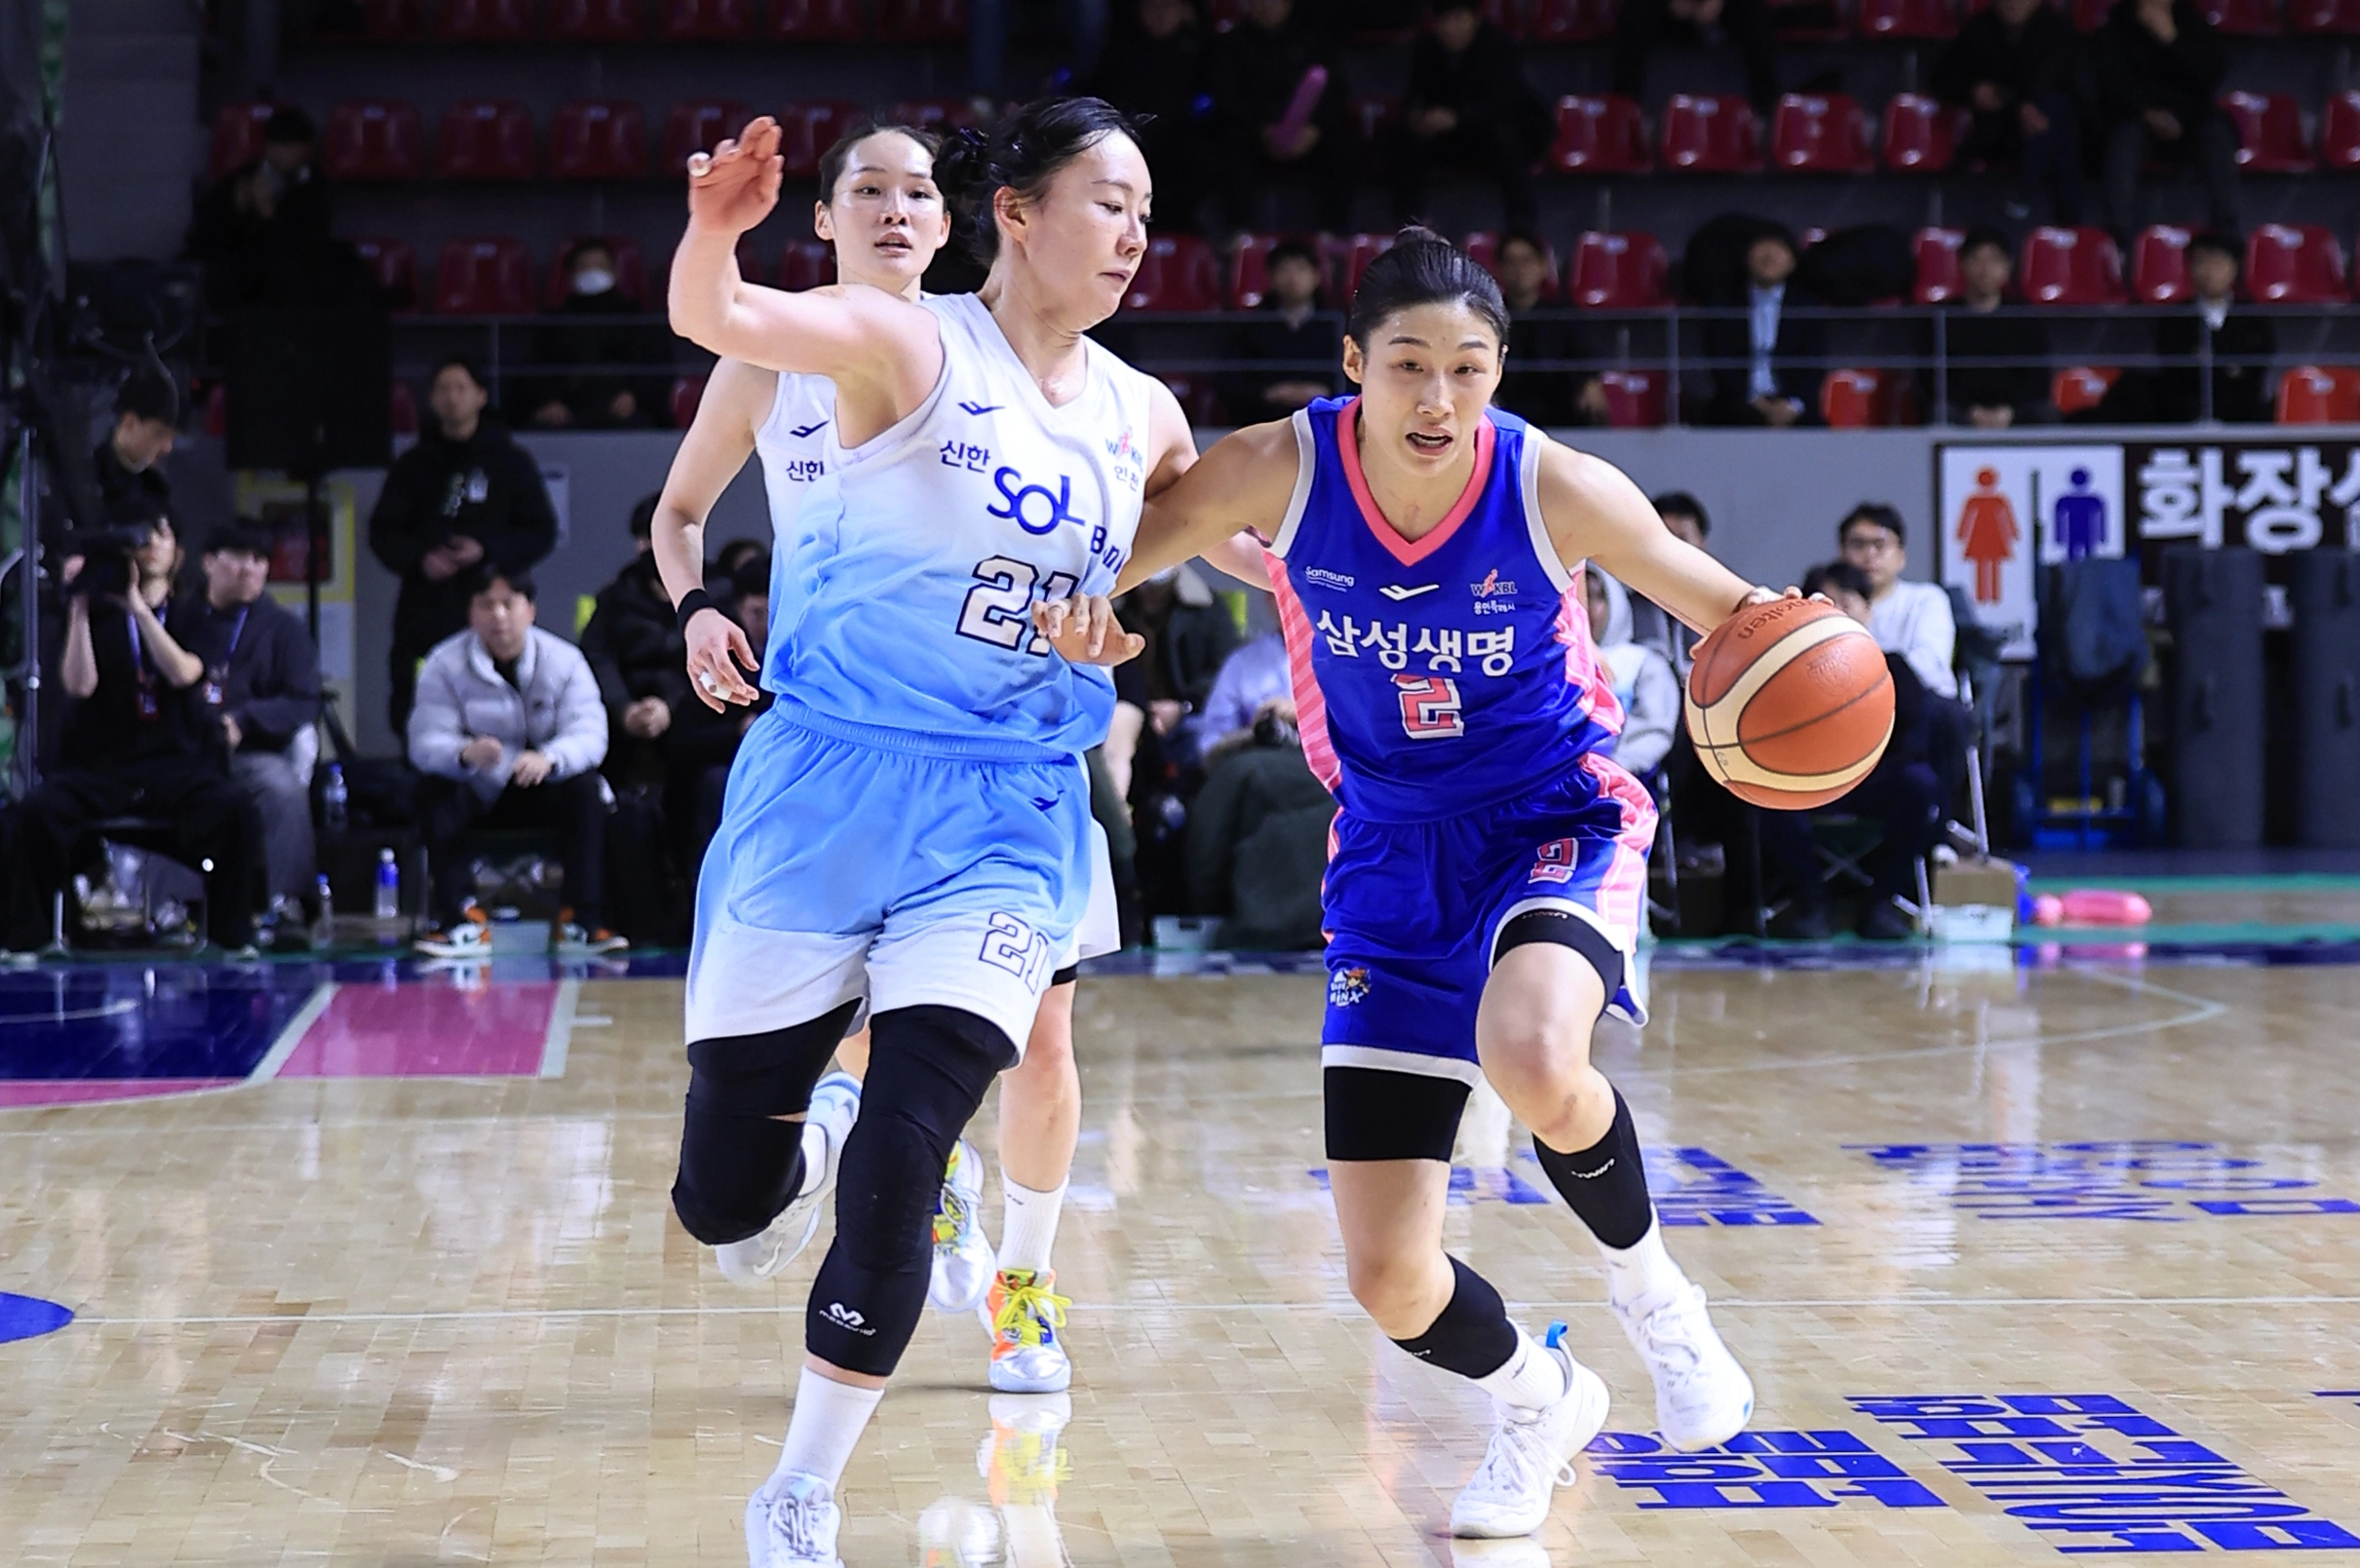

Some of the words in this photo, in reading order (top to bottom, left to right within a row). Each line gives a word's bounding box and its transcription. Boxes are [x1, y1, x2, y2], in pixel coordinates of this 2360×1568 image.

[786, 460, 825, 482] 신한
[940, 440, 991, 474] 신한
[2137, 446, 2360, 555] 화장
[1305, 565, 1355, 588] Samsung
[1316, 609, 1515, 677] 삼성생명
[1391, 672, 1464, 740] 2
[1528, 836, 1579, 884] 2
[978, 910, 1050, 996] 21
